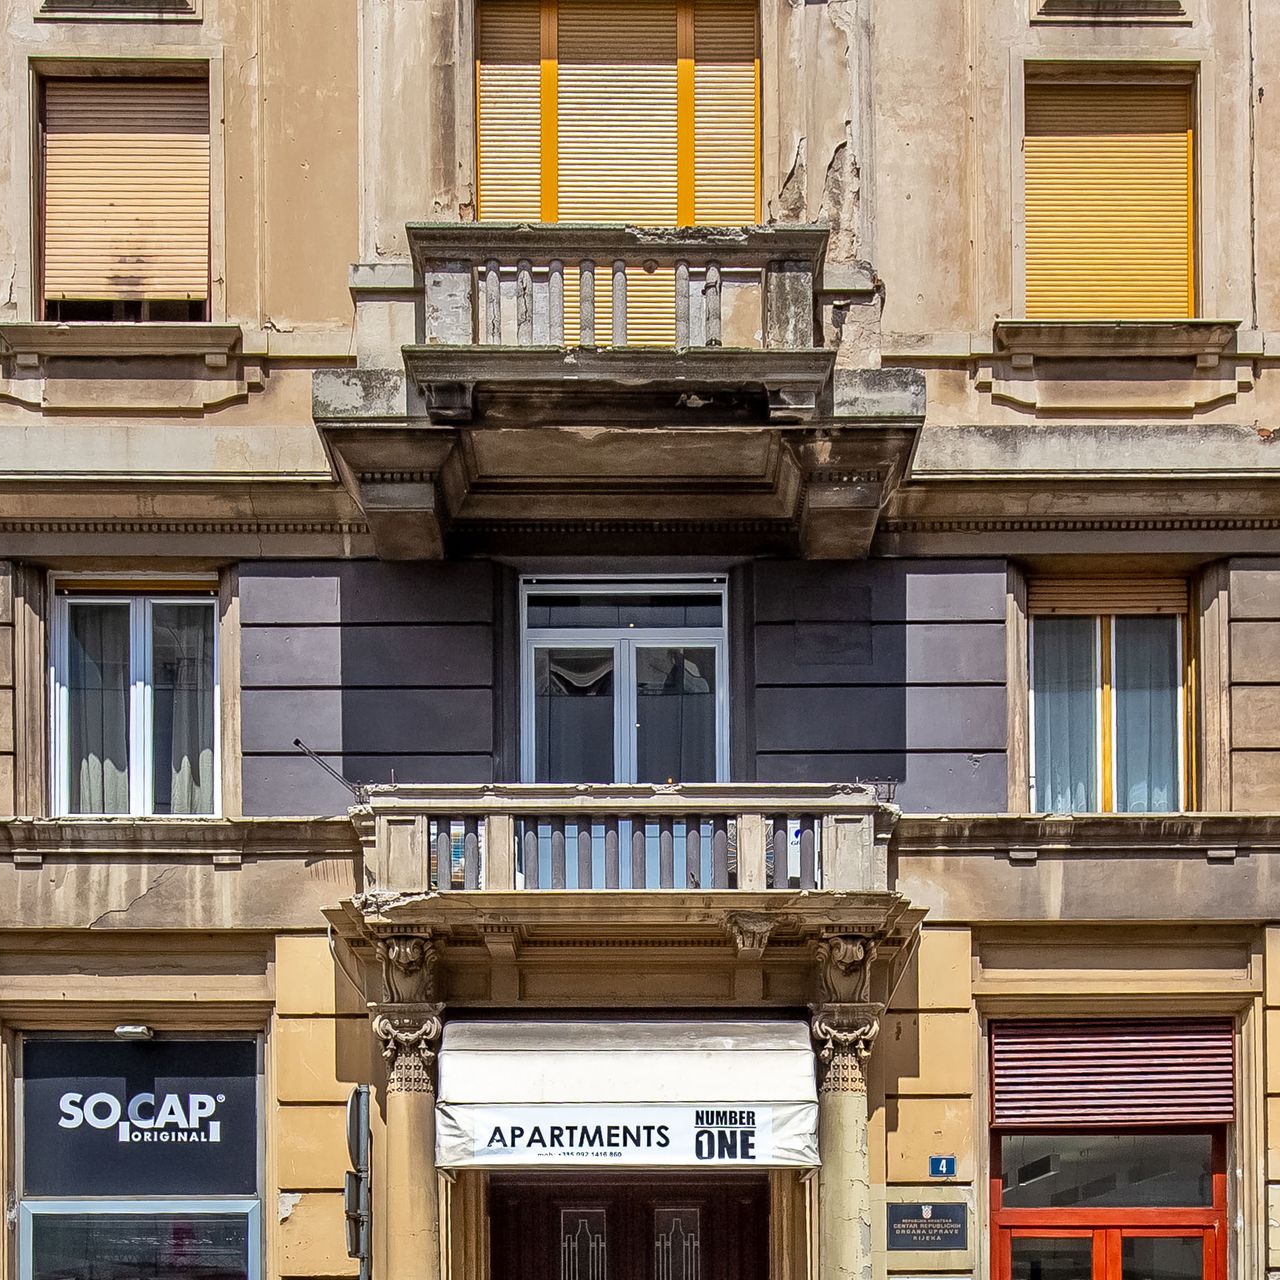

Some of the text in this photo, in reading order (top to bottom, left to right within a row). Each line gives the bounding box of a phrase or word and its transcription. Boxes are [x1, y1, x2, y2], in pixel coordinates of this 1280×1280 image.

[695, 1110, 756, 1126] NUMBER
[131, 1131, 208, 1142] ORIGINAL
[487, 1125, 670, 1148] APARTMENTS
[695, 1130, 756, 1160] ONE
[939, 1159, 947, 1174] 4
